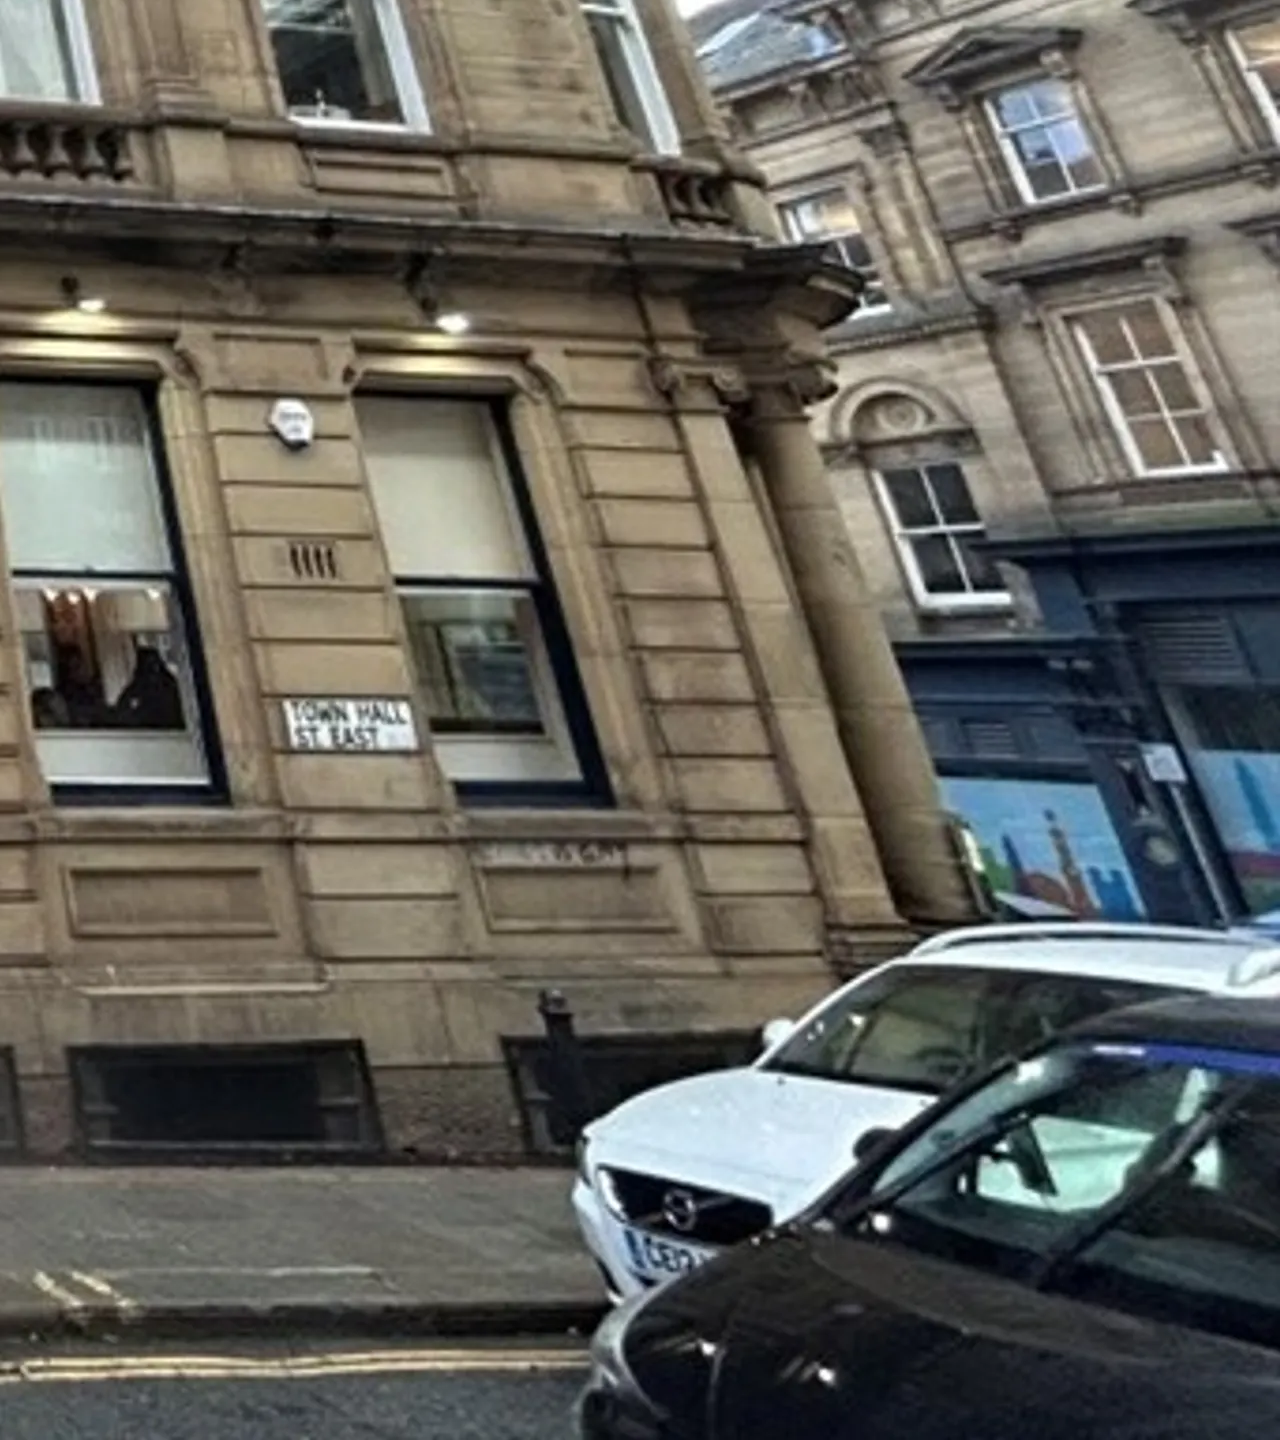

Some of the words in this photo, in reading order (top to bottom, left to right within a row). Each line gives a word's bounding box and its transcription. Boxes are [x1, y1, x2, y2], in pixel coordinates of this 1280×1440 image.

[290, 699, 349, 722] TOWN
[355, 702, 408, 725] HALL
[294, 726, 319, 749] ST
[329, 727, 380, 749] EAST
